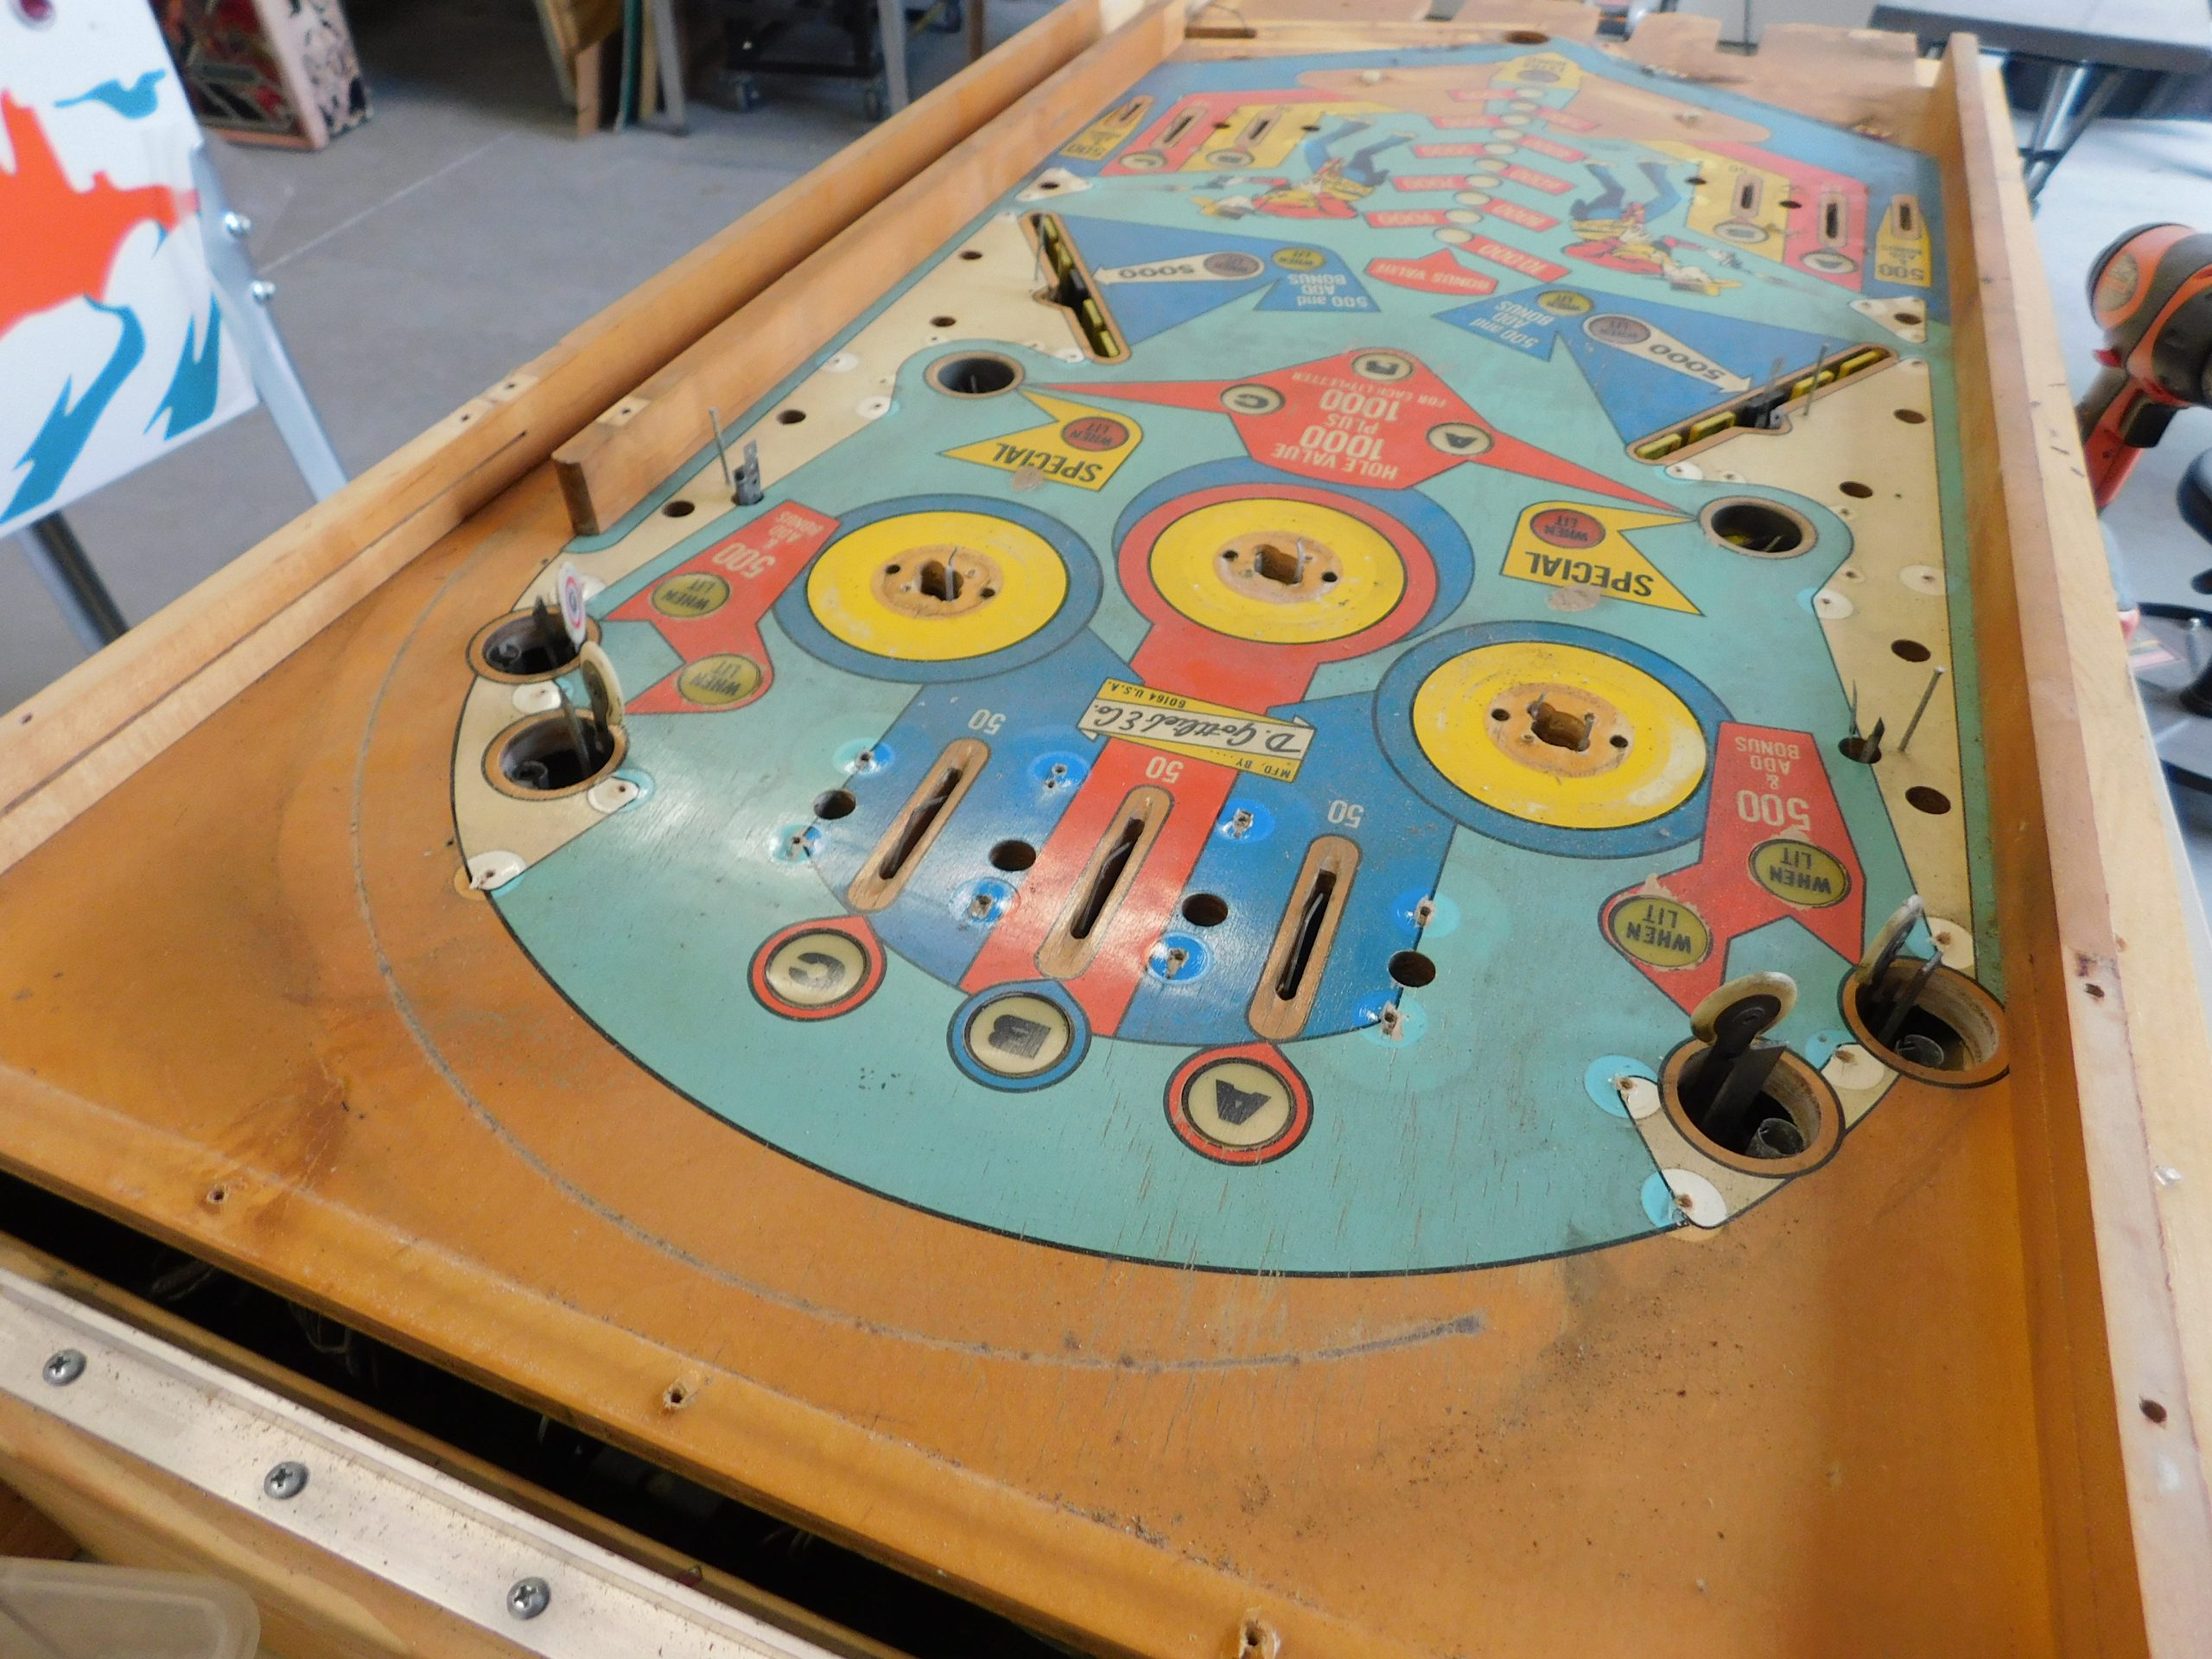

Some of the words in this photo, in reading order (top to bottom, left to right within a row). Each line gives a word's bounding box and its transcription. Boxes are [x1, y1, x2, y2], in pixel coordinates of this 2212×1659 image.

[1117, 264, 1195, 278] 5000
[1287, 274, 1346, 285] BONUS
[1878, 264, 1924, 281] 500
[1301, 284, 1335, 295] ADD
[1297, 296, 1326, 306] and
[1332, 296, 1368, 308] 500
[1492, 312, 1529, 328] ADD
[1494, 301, 1554, 326] BONUS
[1469, 318, 1503, 333] and
[1500, 329, 1539, 348] 500
[1649, 344, 1726, 381] 5000
[1233, 393, 1268, 410] C
[1319, 389, 1400, 422] 1000
[1417, 395, 1447, 408] FOR
[1086, 423, 1109, 435] LIT
[1321, 413, 1380, 435] PLUS
[1070, 430, 1113, 448] WHEN
[1300, 425, 1384, 461] 1000
[1446, 433, 1478, 449] A
[991, 442, 1103, 482] SPECIAL
[1270, 442, 1337, 469] VALUE
[1341, 457, 1398, 480] HOLE
[1544, 525, 1588, 542] WHEN
[1554, 516, 1578, 529] LIT
[711, 543, 776, 579] 500
[1524, 551, 1655, 597] SPECIAL
[686, 579, 715, 594] LIT
[662, 589, 709, 610] WHEN
[690, 673, 741, 696] WHEN
[1107, 680, 1144, 698] U.S.A.
[1148, 692, 1186, 709] 60164
[967, 708, 1007, 735] 50
[1093, 704, 1123, 727] Co.
[1141, 714, 1257, 747] Gottlieb
[1266, 729, 1301, 753] D.
[1735, 736, 1800, 760] BONUS
[1145, 756, 1184, 784] 50
[1750, 755, 1790, 775] ADD
[1765, 773, 1779, 790] &
[1328, 800, 1364, 829] 50
[1737, 790, 1811, 830] 500
[1780, 848, 1812, 869] LIT
[1770, 865, 1832, 894] WHEN
[1642, 905, 1678, 928] LIT
[1626, 921, 1691, 954] WHEN
[788, 952, 846, 992] C
[987, 1014, 1052, 1059] B
[1216, 1079, 1272, 1126] A
